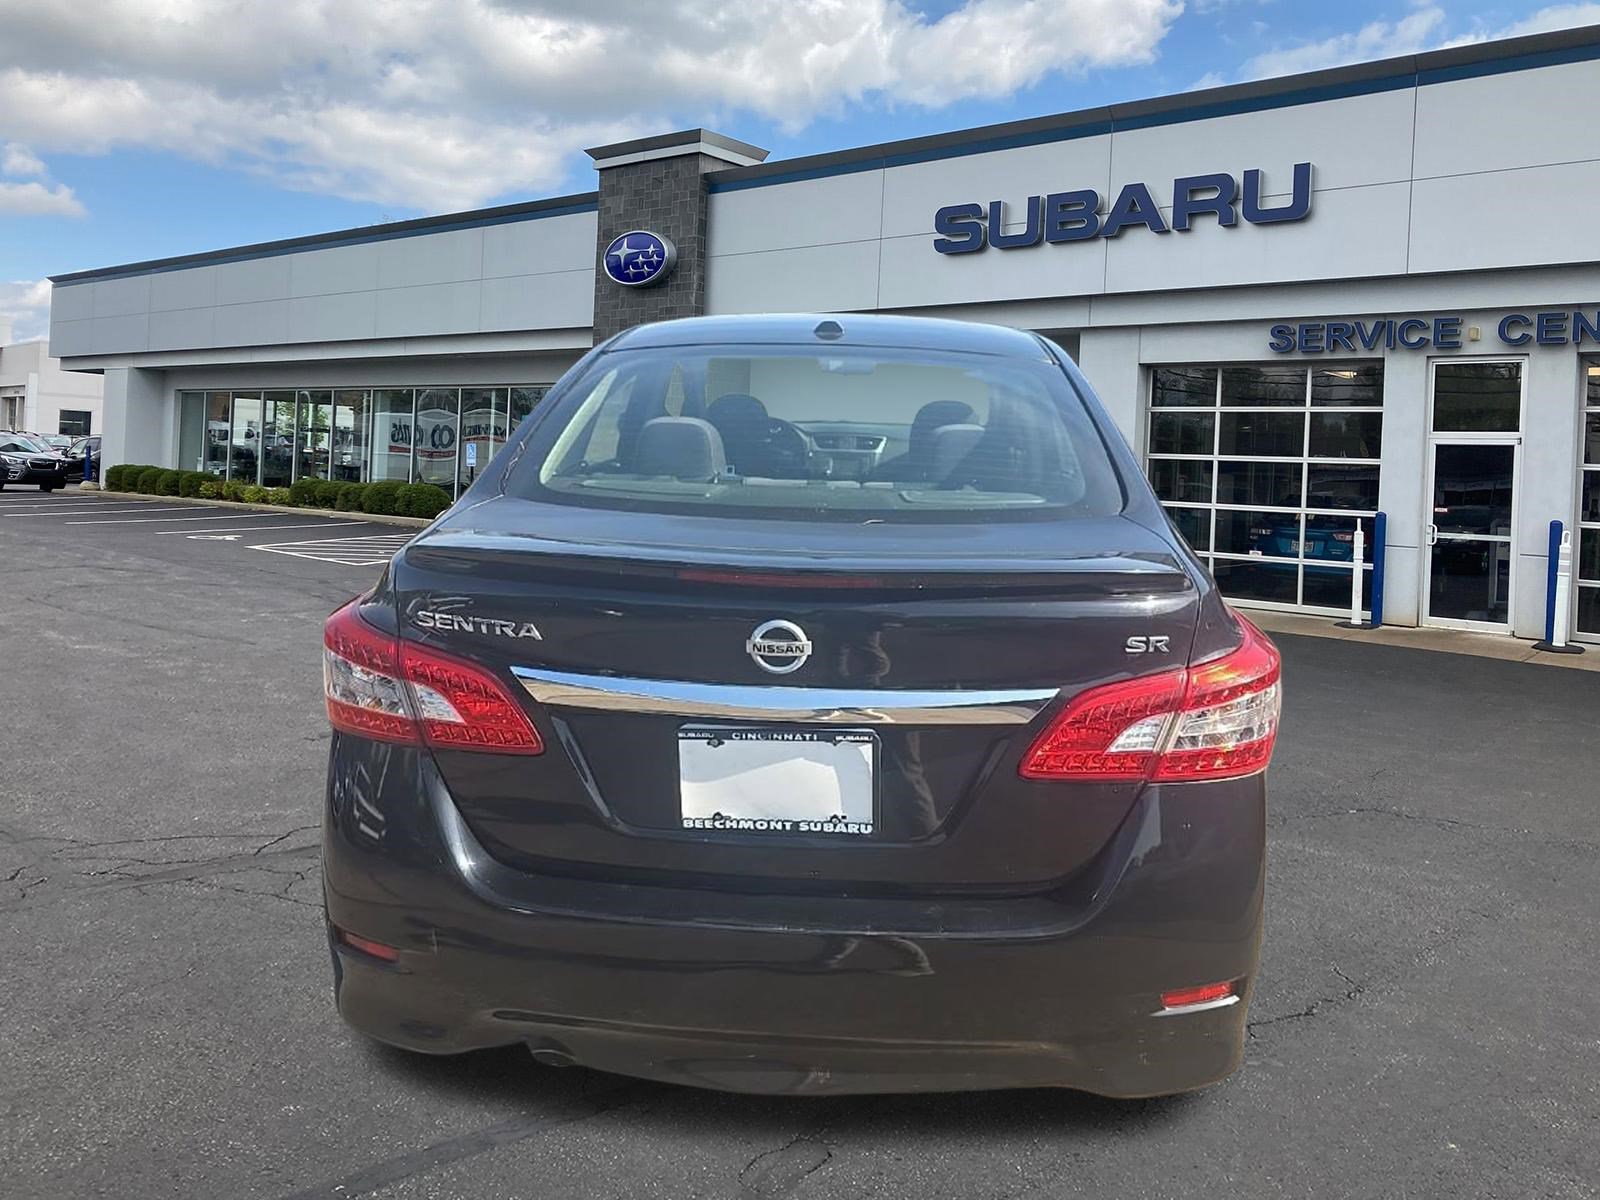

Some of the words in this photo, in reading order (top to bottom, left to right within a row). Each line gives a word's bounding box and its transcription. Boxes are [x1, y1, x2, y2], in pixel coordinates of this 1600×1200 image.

[934, 162, 1313, 255] SUBARU
[1269, 317, 1464, 352] SERVICE
[416, 610, 543, 640] SENTRA
[752, 643, 805, 654] NISSAN
[1125, 635, 1170, 653] SR
[683, 818, 793, 831] BEECHMONT
[799, 820, 873, 834] SUBARU
